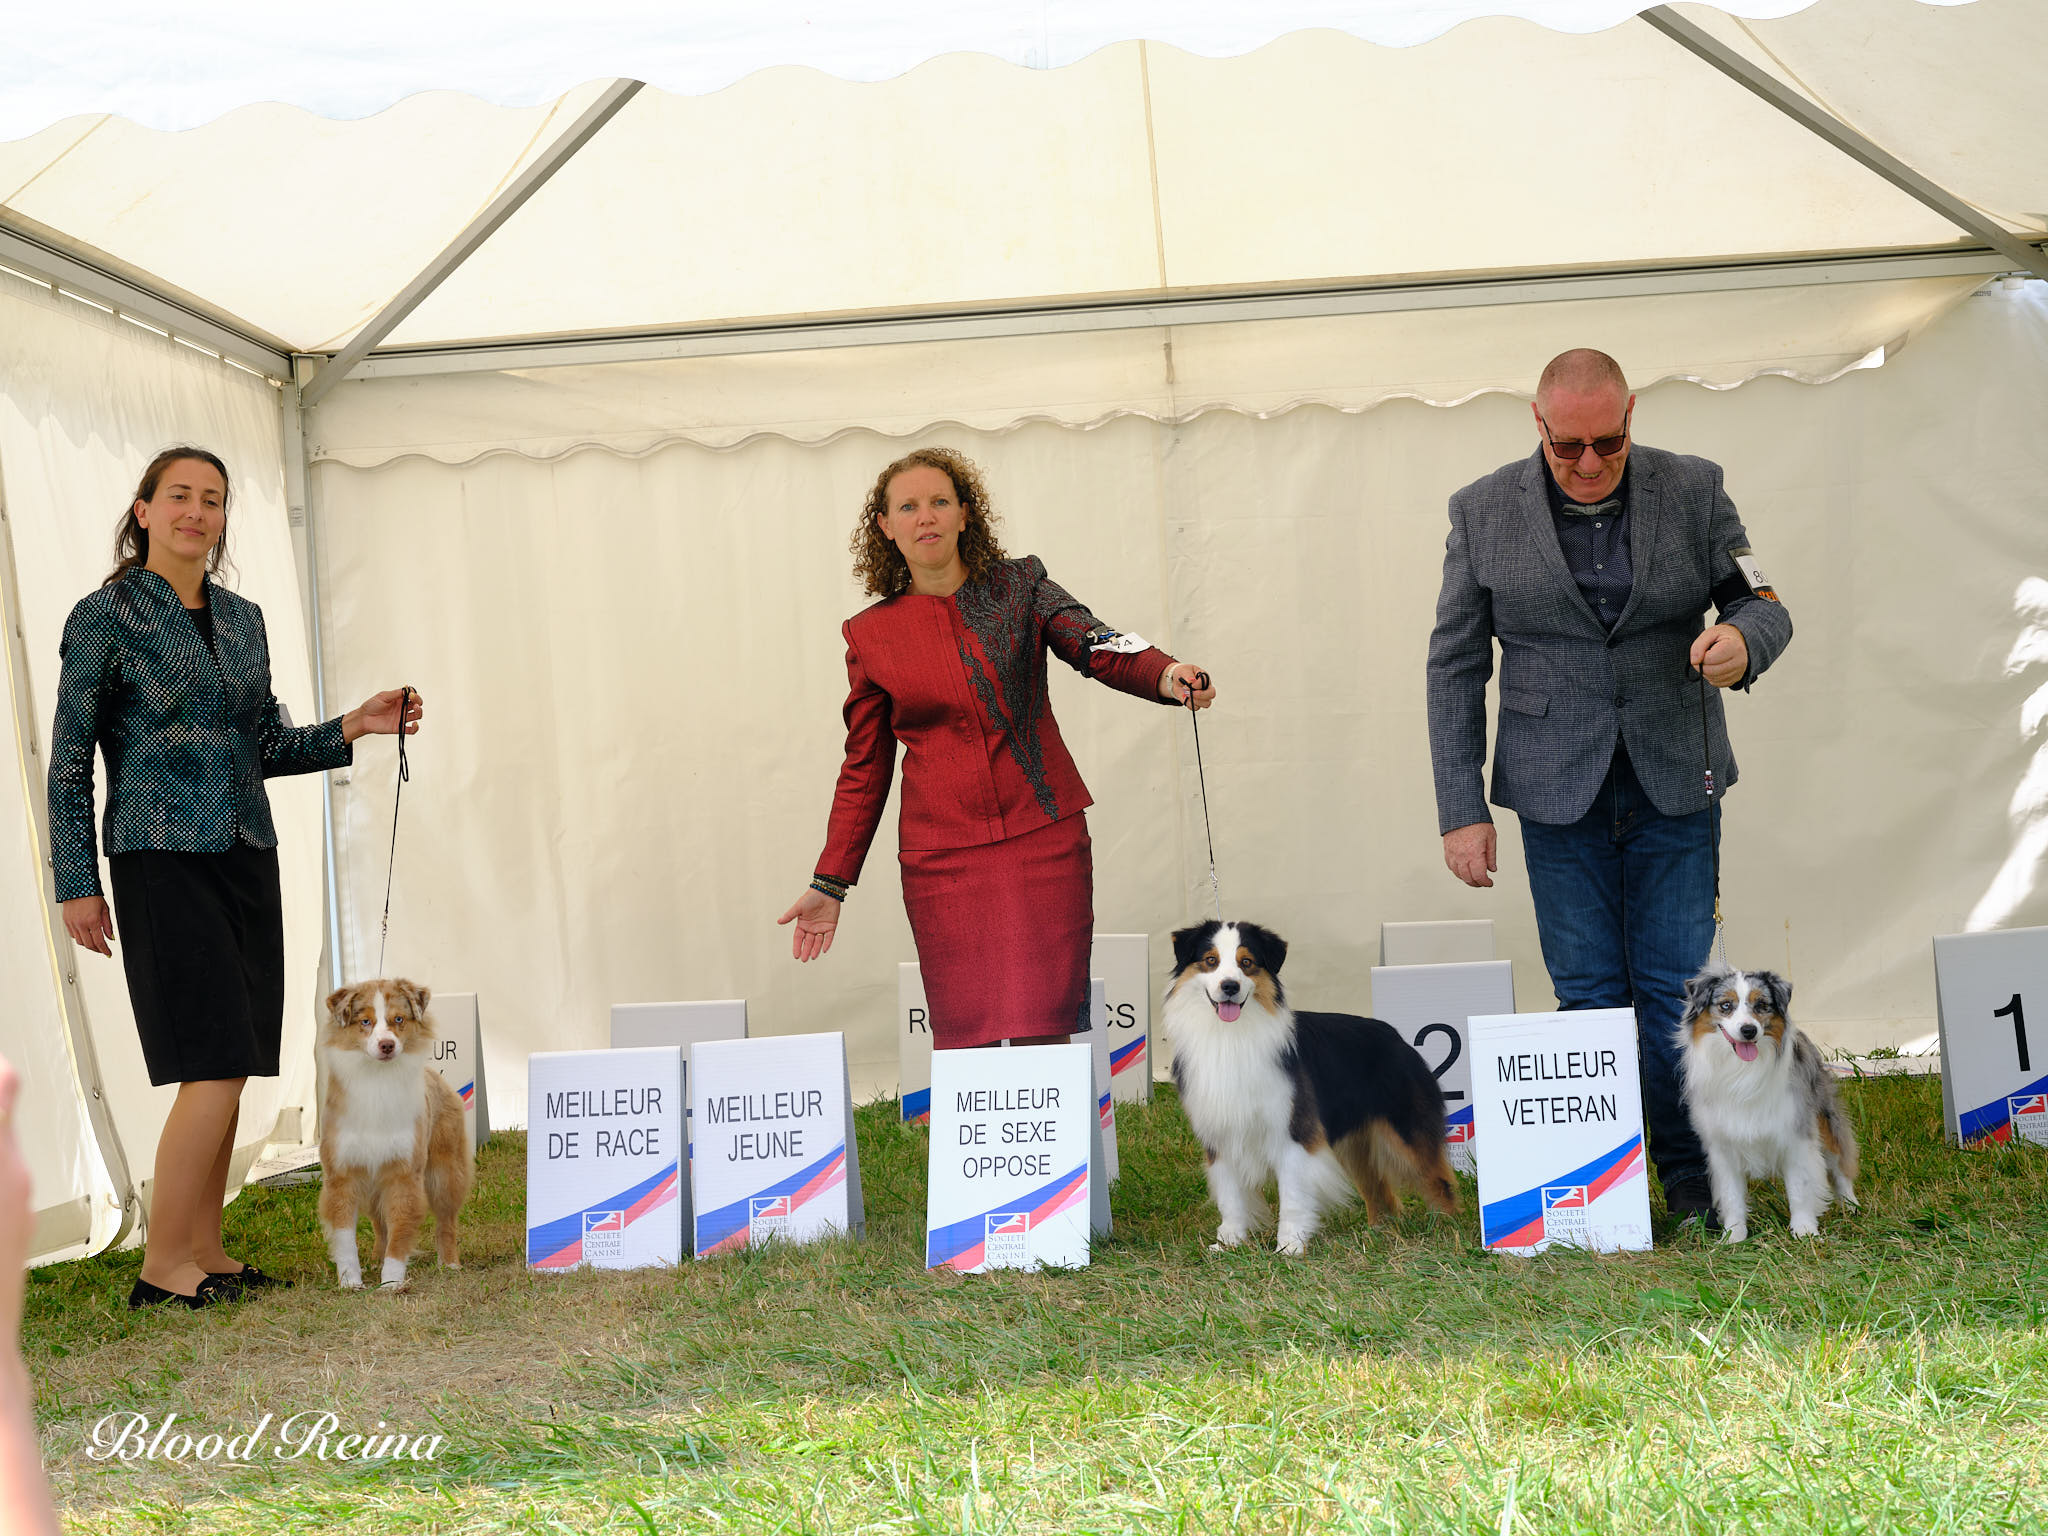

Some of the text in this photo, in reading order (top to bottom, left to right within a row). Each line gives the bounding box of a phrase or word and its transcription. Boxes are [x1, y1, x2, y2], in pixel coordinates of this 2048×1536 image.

[1993, 993, 2031, 1072] 1
[1413, 1023, 1465, 1101] 2
[1498, 1050, 1618, 1083] MEILLEUR
[547, 1087, 662, 1120] MEILLEUR
[707, 1089, 823, 1125] MEILLEUR
[956, 1087, 1061, 1113] MEILLEUR
[1502, 1094, 1618, 1127] VETERAN
[549, 1128, 660, 1160] DE RACE
[727, 1130, 804, 1162] JEUNE
[959, 1120, 1057, 1146] DE SEXE
[963, 1154, 1051, 1179] OPPOSE
[1546, 1218, 1586, 1227] CENTRALE
[584, 1240, 621, 1249] CENTRALE
[584, 1249, 621, 1257] CANINE
